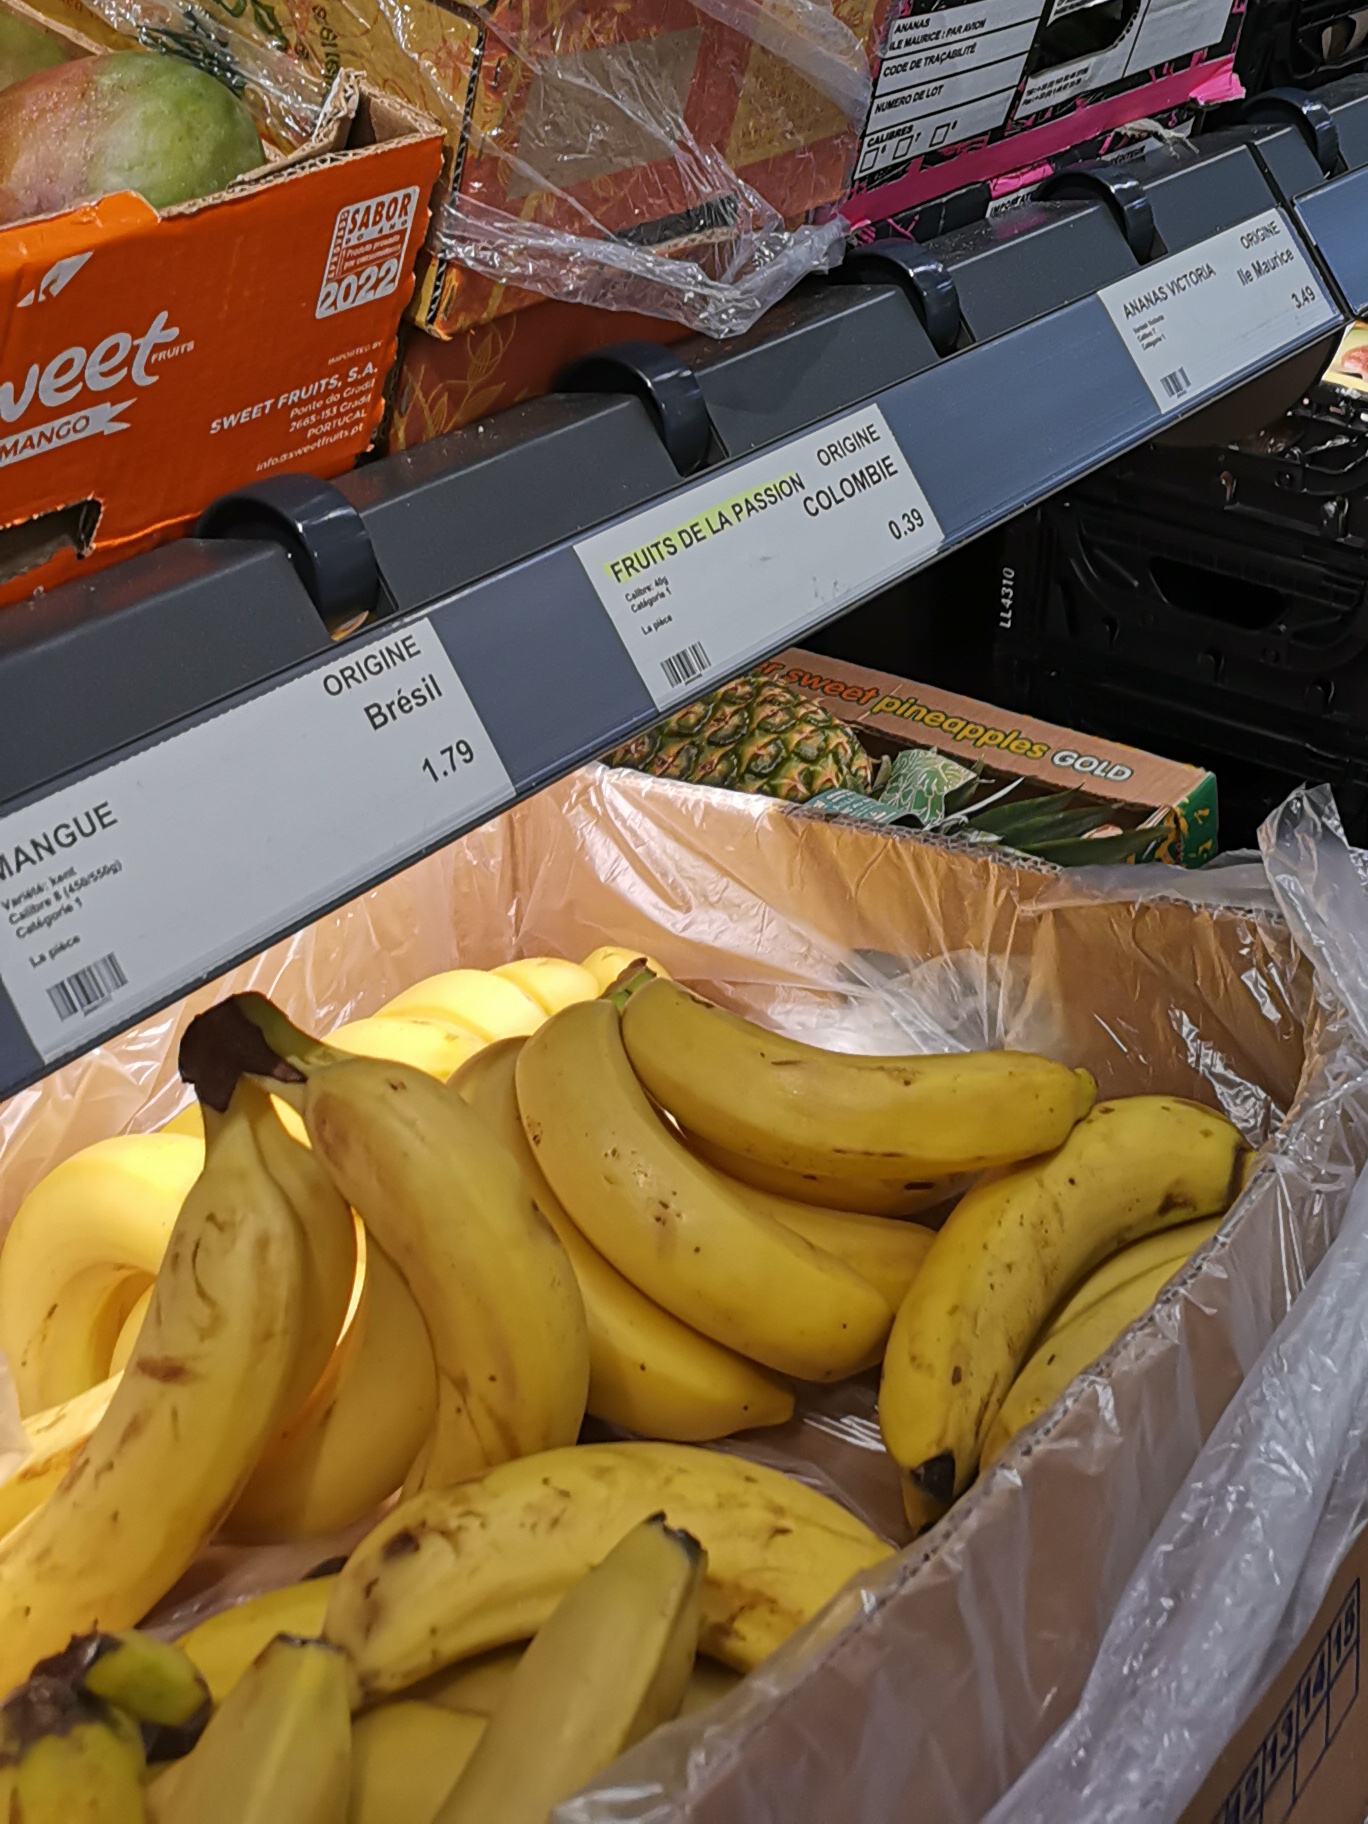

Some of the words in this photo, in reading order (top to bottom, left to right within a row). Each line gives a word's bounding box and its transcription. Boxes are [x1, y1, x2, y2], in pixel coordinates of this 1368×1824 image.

[894, 18, 930, 35] ANANAS
[904, 30, 941, 48] MAURICE
[945, 25, 962, 38] PAR
[963, 18, 986, 33] AVION
[883, 61, 909, 77] CODE
[909, 58, 922, 71] DE
[923, 42, 977, 66] TRAÇABILITÉ
[912, 91, 924, 103] DE
[926, 84, 944, 99] LOT
[867, 124, 913, 148] CALIBRES
[348, 193, 412, 236] SABOR
[1240, 221, 1281, 249] ORIGINE
[319, 258, 398, 312] 2022
[1236, 269, 1251, 286] Ile
[1251, 248, 1294, 279] Maurice
[1122, 286, 1169, 320] ANANAS
[1166, 263, 1217, 296] VICTORIA
[1291, 285, 1316, 309] 3.49
[0, 311, 180, 423] weet
[150, 341, 195, 364] FRUITS
[210, 399, 275, 434] SWEET
[277, 375, 342, 409] FRUITS,
[347, 362, 378, 382] S.A.
[290, 399, 323, 419] Ponte
[326, 393, 340, 405] do
[307, 409, 367, 439] PORTUGAL
[817, 423, 881, 467] ORIGINE
[803, 455, 899, 517] COLOMBIE
[609, 536, 678, 583] FRUITS
[677, 521, 707, 550] DE
[705, 510, 732, 536] LA
[731, 473, 806, 522] PASSION
[888, 507, 925, 541] 0.39
[999, 566, 1016, 629] LL4310
[323, 634, 421, 696] ORIGINE
[363, 674, 443, 731] Brésil
[781, 666, 881, 707] sweet
[870, 694, 1052, 762] pineapples
[1050, 748, 1135, 784] GOLD
[422, 739, 474, 783] 1.79
[29, 953, 47, 968] La
[1301, 1650, 1326, 1719] 14
[1333, 1596, 1355, 1664] 15
